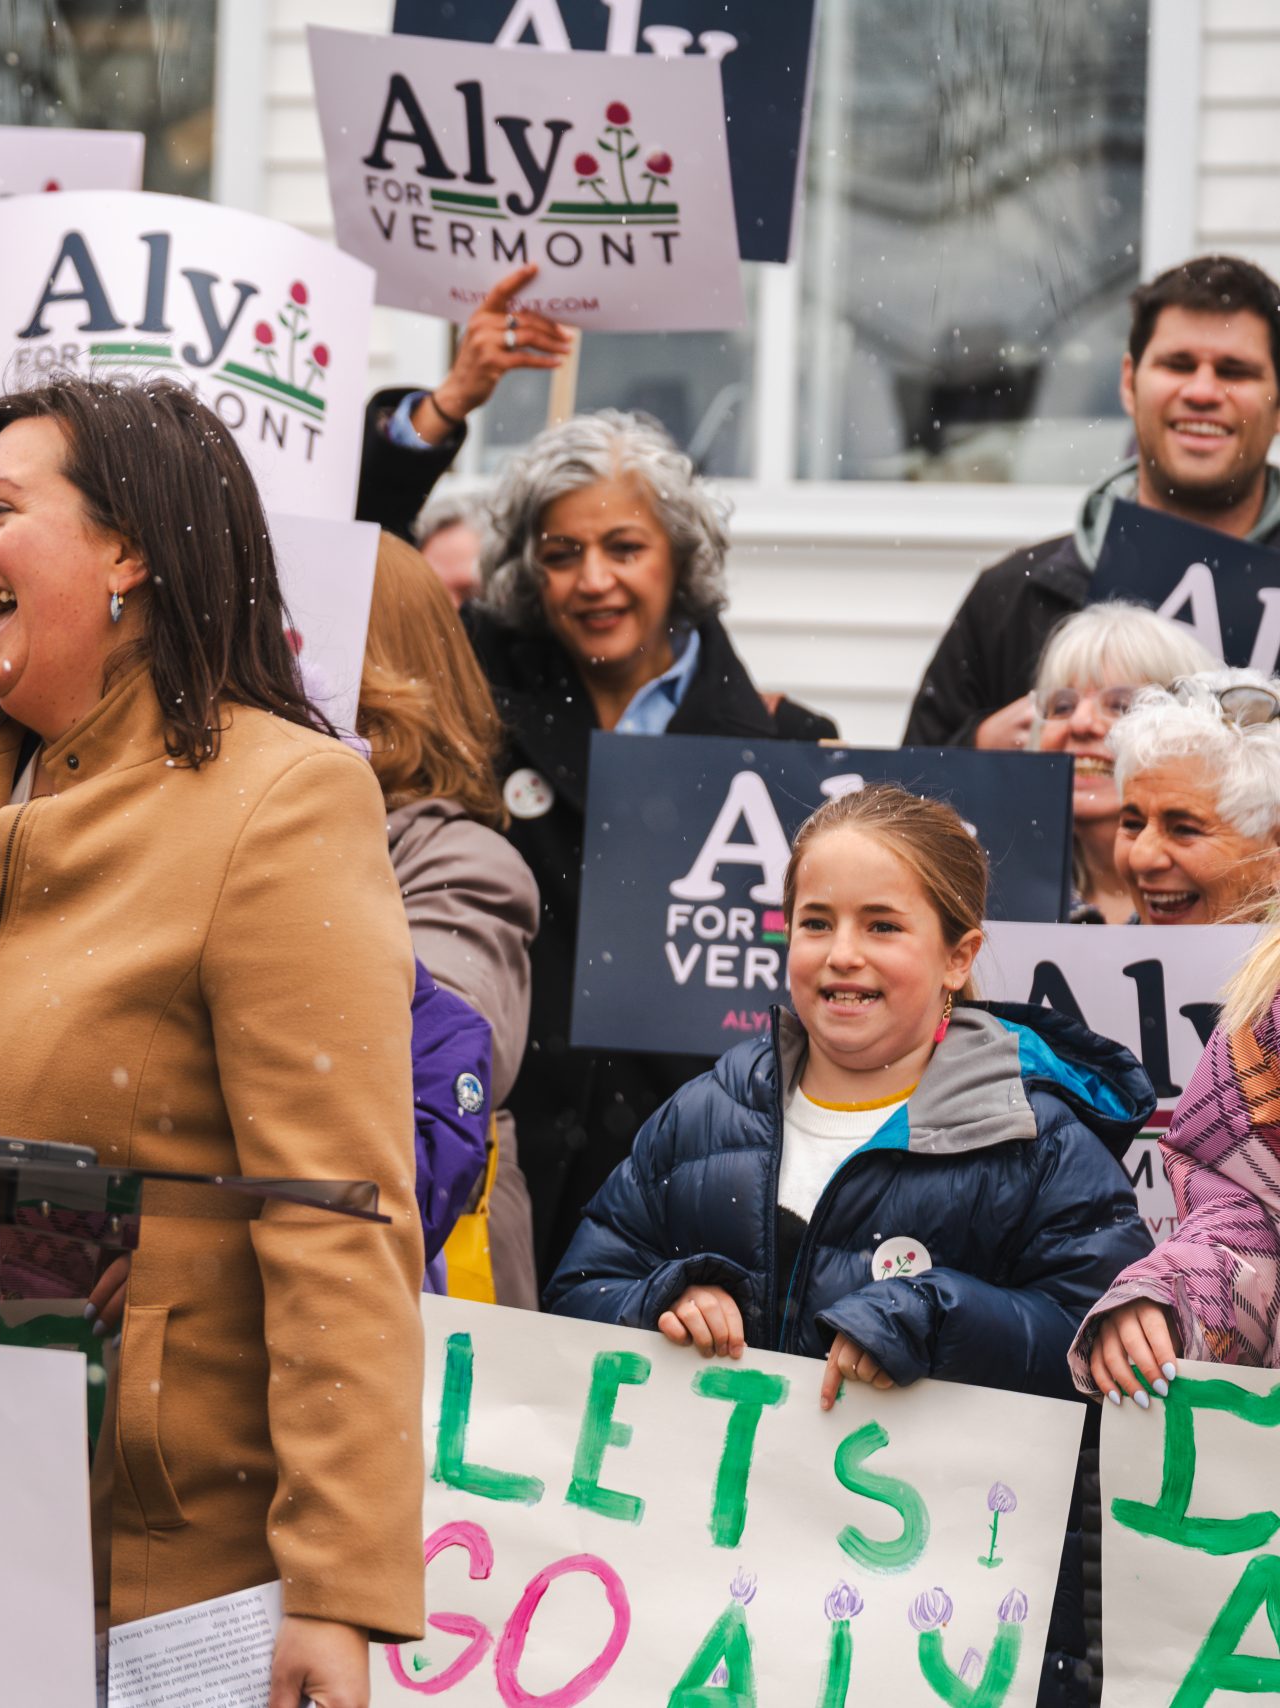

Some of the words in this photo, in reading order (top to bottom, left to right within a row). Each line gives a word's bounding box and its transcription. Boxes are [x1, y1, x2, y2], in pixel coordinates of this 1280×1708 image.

[362, 72, 574, 216] Aly
[365, 175, 423, 206] FOR
[369, 205, 681, 267] VERMONT
[18, 229, 259, 369] Aly
[666, 904, 755, 943] FOR
[431, 1332, 931, 1576] LETS
[208, 1605, 229, 1616] found
[184, 1611, 207, 1623] myself
[228, 1616, 239, 1624] the
[153, 1619, 182, 1631] working
[118, 1630, 142, 1642] Barack
[204, 1631, 220, 1641] your
[222, 1629, 232, 1637] for
[165, 1638, 203, 1653] community
[175, 1652, 192, 1662] work
[193, 1647, 207, 1657] and
[225, 1649, 238, 1658] and
[125, 1656, 142, 1667] hand
[183, 1661, 197, 1670] that
[198, 1655, 218, 1666] belief
[125, 1667, 141, 1676] Take
[152, 1665, 182, 1678] anything
[200, 1663, 230, 1675] Vermont
[251, 1667, 262, 1675] the
[115, 1675, 143, 1689] possible
[171, 1671, 199, 1685] instilled
[220, 1671, 249, 1684] Vermont
[150, 1682, 161, 1690] me
[165, 1685, 201, 1699] Neighbors
[229, 1683, 251, 1697] pulled
[121, 1687, 143, 1698] strong
[150, 1694, 164, 1706] pull
